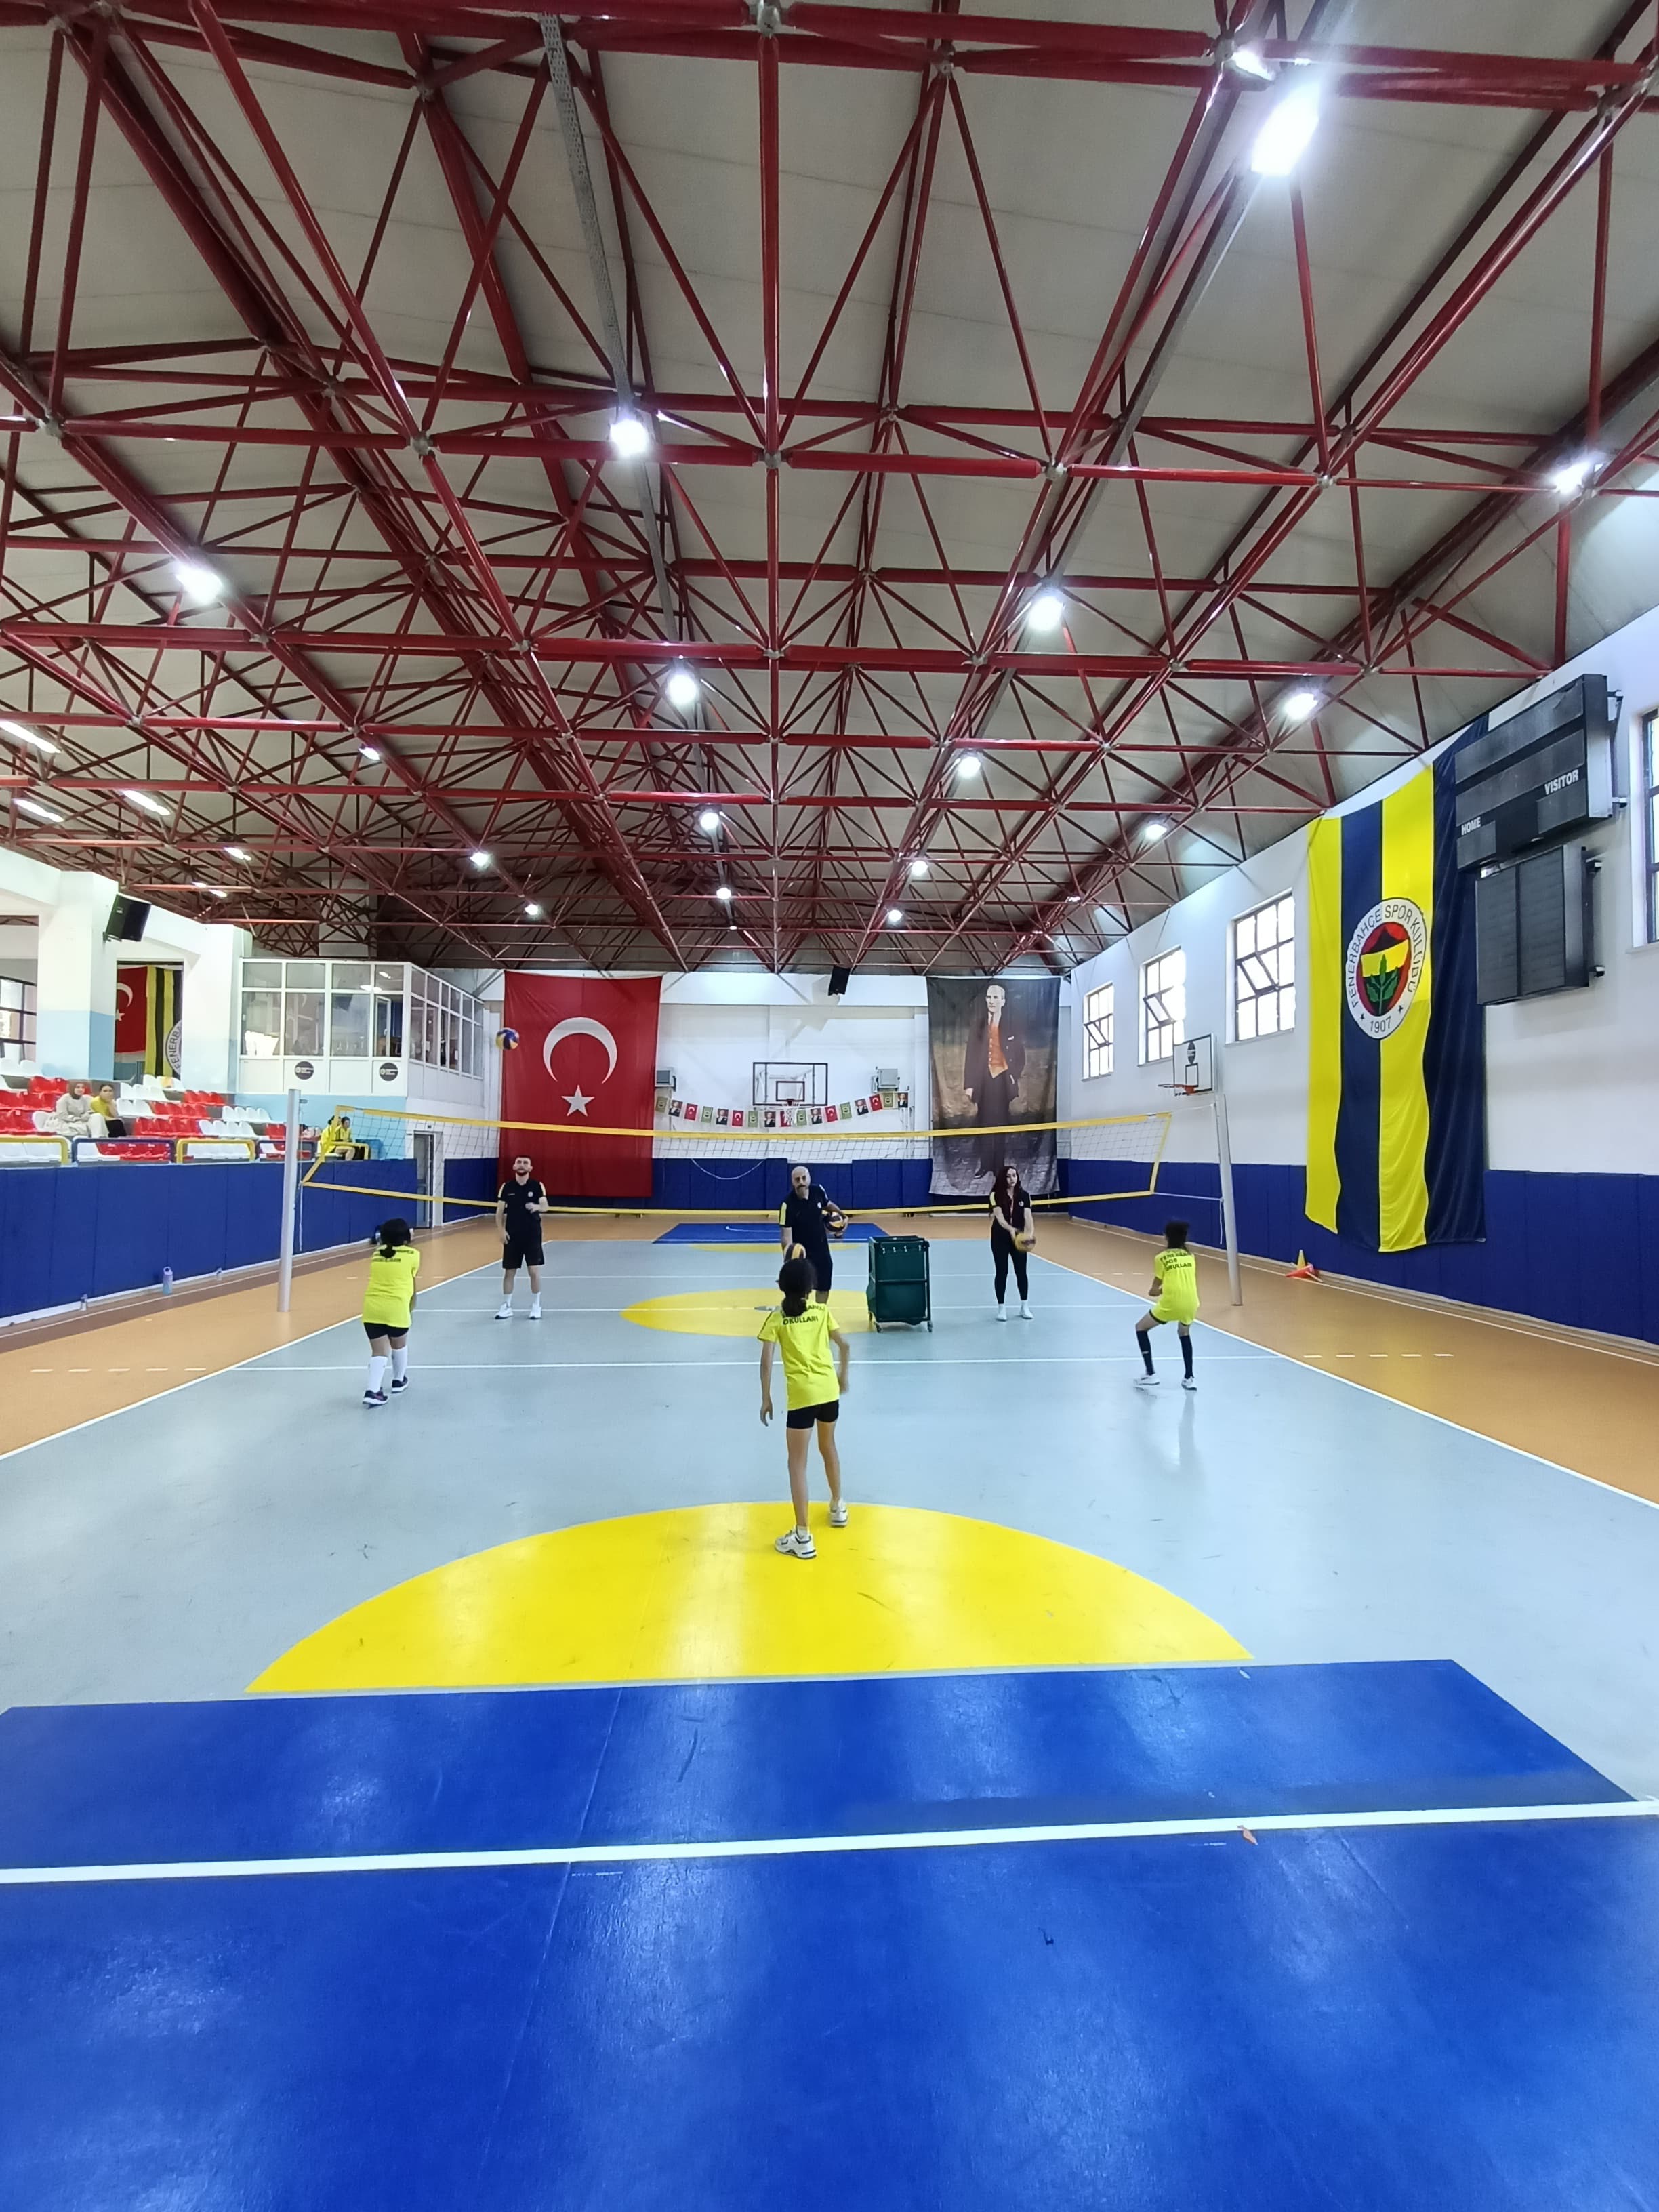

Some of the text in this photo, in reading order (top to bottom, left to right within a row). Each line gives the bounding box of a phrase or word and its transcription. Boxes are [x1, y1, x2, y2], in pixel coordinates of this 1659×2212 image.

[1544, 769, 1579, 795] VISITOR
[1461, 817, 1481, 835] HOME
[1348, 909, 1382, 1008] FENERBAHÇE
[1385, 904, 1412, 924] SPOR
[1370, 1015, 1391, 1033] 1907
[783, 1315, 819, 1325] OKULLARI
